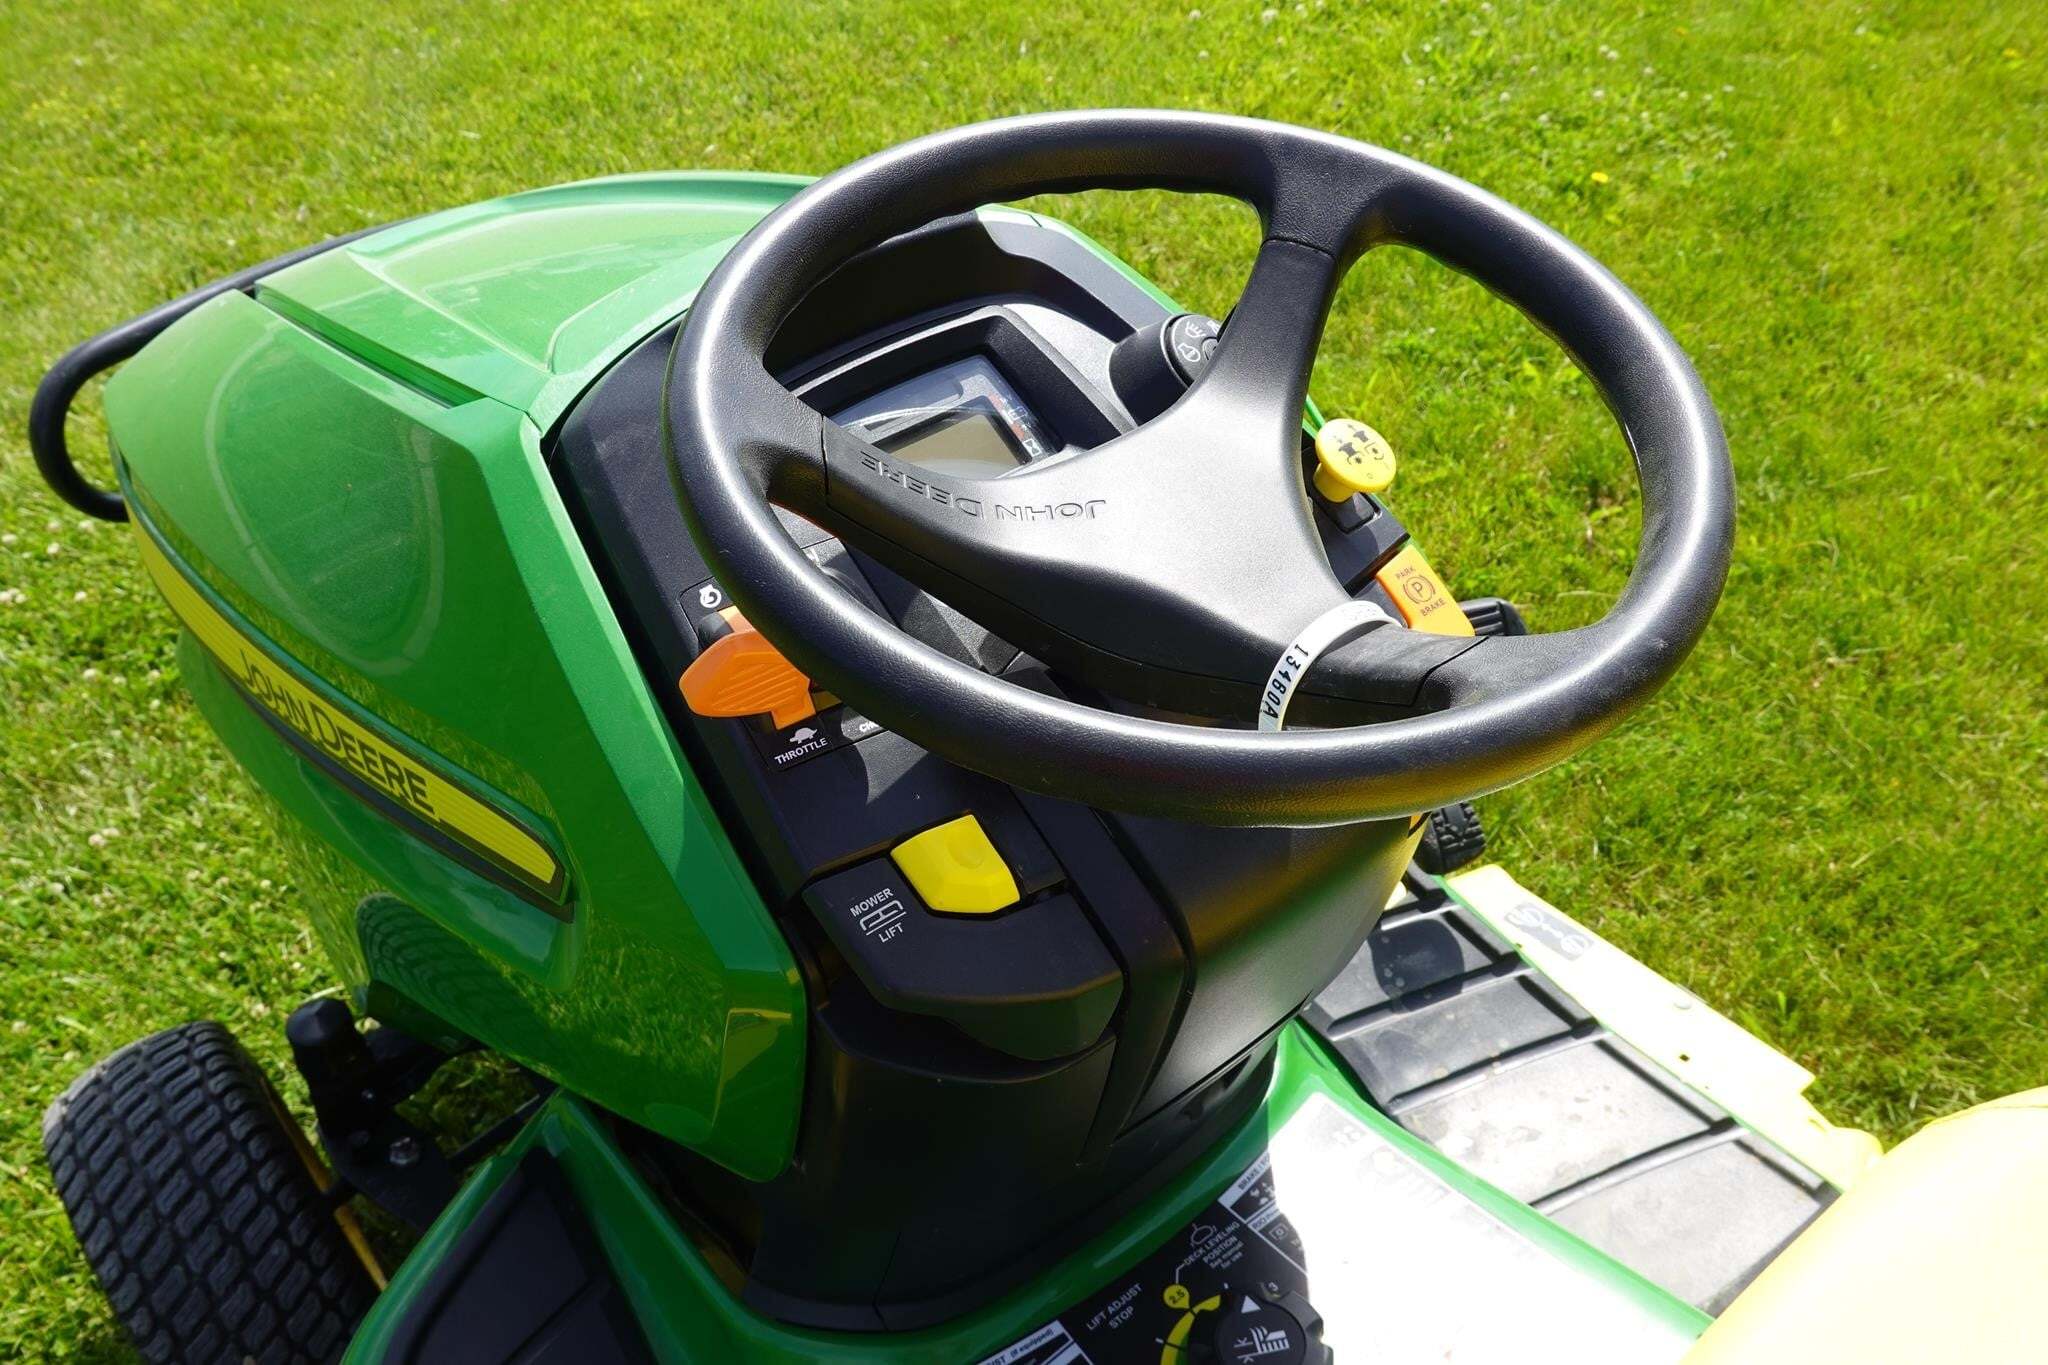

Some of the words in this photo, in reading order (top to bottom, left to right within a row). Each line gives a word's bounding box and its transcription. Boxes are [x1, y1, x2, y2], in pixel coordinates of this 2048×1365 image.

[860, 451, 986, 521] DEERE
[995, 500, 1107, 522] JOHN
[1395, 565, 1417, 580] PARK
[1420, 597, 1446, 617] BRAKE
[1260, 643, 1309, 719] 13460A
[240, 648, 313, 736] JOHN
[309, 702, 436, 816] DEERE
[774, 737, 829, 765] THROTTLE
[850, 888, 894, 917] MOWER
[878, 922, 903, 943] LIFT
[1204, 1221, 1241, 1250] LEVELING
[1203, 1236, 1238, 1264] POSITION
[1086, 1310, 1107, 1331] LIFT
[1107, 1282, 1143, 1315] ADJUST
[1168, 1288, 1186, 1304] 2.5
[1108, 1305, 1134, 1329] STOP
